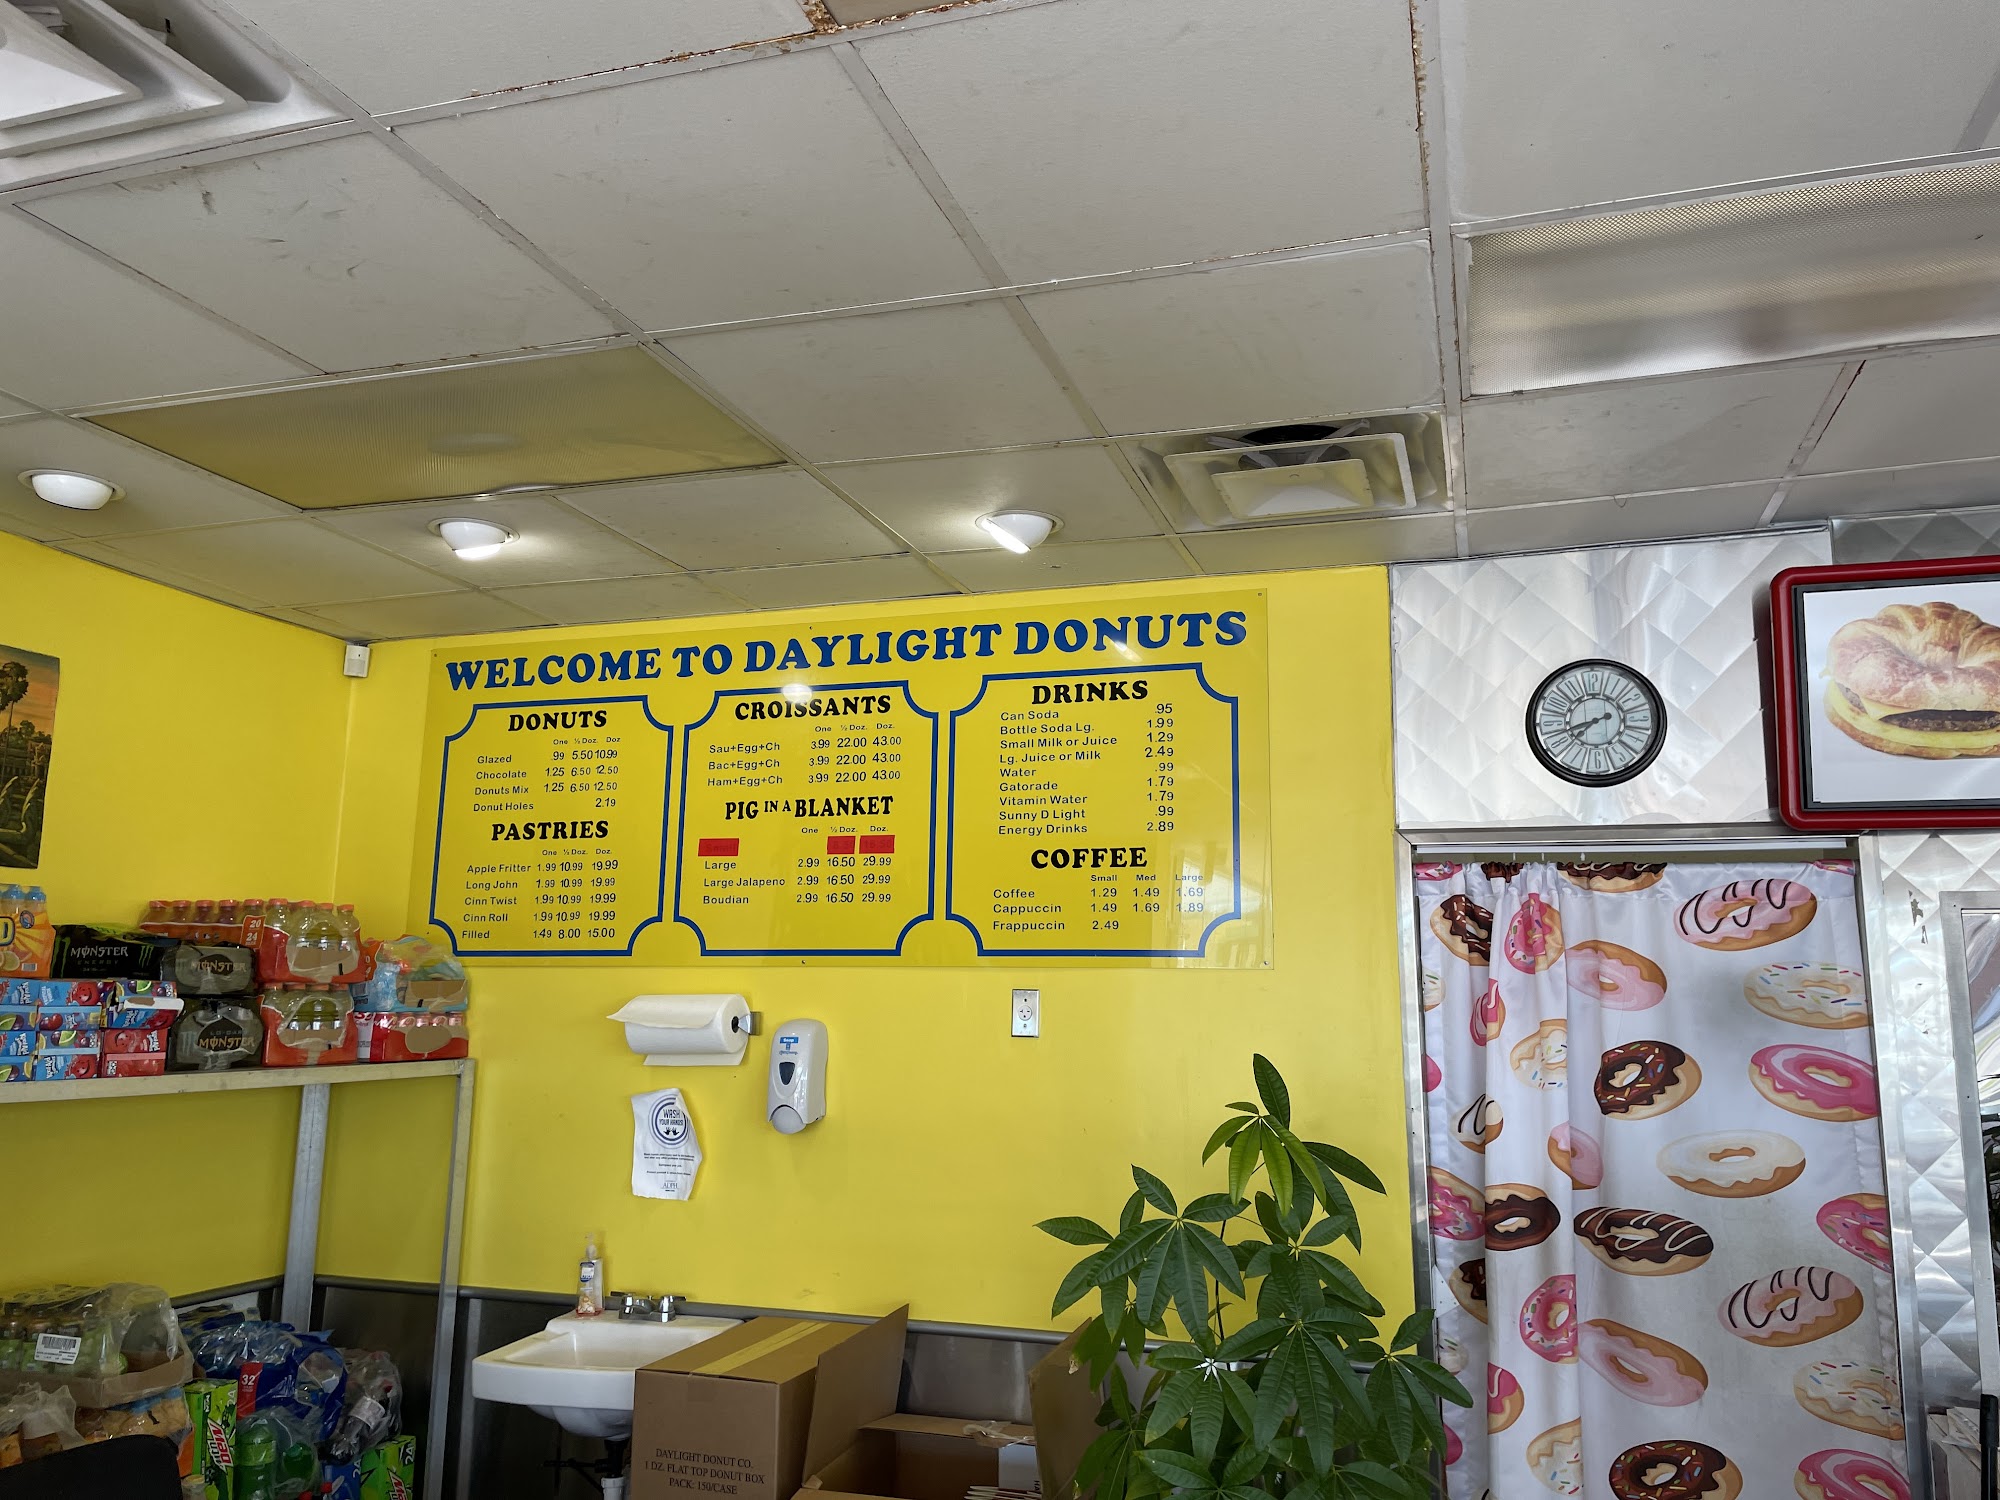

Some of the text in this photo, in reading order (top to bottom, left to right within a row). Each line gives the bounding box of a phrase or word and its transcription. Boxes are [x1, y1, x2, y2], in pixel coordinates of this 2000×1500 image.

[446, 611, 1246, 690] WELCOME TO DAYLIGHT DONUTS
[1588, 673, 1598, 691] 12
[1032, 680, 1148, 704] DRINKS
[735, 695, 890, 720] CROISSANTS
[1001, 704, 1172, 720] Can Soda .95
[508, 710, 606, 731] DONUTS
[1001, 718, 1173, 734] Bottle Soda Lg. 1.99
[710, 736, 901, 753] Sau+Egg+Ch 3.99 22.00 43.00
[1001, 739, 1033, 748] Small
[1038, 738, 1062, 747] Milk
[1082, 736, 1116, 745] Juice
[1147, 732, 1173, 742] 1.29
[478, 750, 617, 764] Glazed .99 5.50 10.99
[709, 753, 900, 770] Bac+Egg+Ch 3.99 22.00 43.00
[1000, 755, 1017, 765] Lg.
[1022, 753, 1055, 762] Juice
[1076, 751, 1100, 760] Milk
[1145, 746, 1173, 757] 2.49
[476, 765, 618, 779] Chocolate 1.25 6.50 12.50
[1000, 763, 1173, 777] Water .99
[708, 770, 900, 787] Ham+Egg+Ch 3.99 22.00 43.00
[1000, 776, 1173, 791] Gatorade 1.79
[475, 787, 509, 795] Donuts
[544, 782, 564, 792] 1.25
[570, 783, 589, 792] 6.50
[594, 782, 617, 791] 12.50
[474, 798, 615, 811] Donut Holes 2.19
[1000, 791, 1173, 805] Vitamin Water 1.79
[726, 796, 893, 820] PIG IN A BLANKET
[1000, 806, 1173, 821] Sunny D Light .99
[492, 821, 608, 840] PASTRIES
[999, 821, 1173, 836] Energy Drinks 2.89
[705, 856, 891, 871] Large 2.99 16.50 29.99
[1031, 847, 1147, 869] COFFEE
[467, 860, 618, 875] Apple Fritter 1.99 10.99 19.99
[466, 881, 490, 891] Long
[536, 879, 555, 888] 1.99
[560, 879, 582, 888] 10.99
[591, 877, 615, 886] 19.99
[704, 873, 890, 888] Large Jalapeno 2.99 16.50 29.99
[465, 897, 487, 905] Cinn
[535, 894, 554, 904] 1.99
[557, 894, 581, 904] 10.99
[590, 893, 616, 903] 19.99
[704, 892, 891, 904] Boudian 2.99 16.50 29.99
[994, 887, 1204, 898] Coffee 1.29 1.49 1.69
[464, 914, 486, 922] Cinn
[534, 912, 552, 921] 1.99
[556, 911, 580, 922] 10.99
[589, 911, 615, 921] 19.99
[994, 903, 1204, 915] Cappuccin 1.49 1.69 1.89
[462, 928, 615, 939] Filled 1.49 8.00 15.00
[994, 921, 1118, 932] Frappuccin 2.49
[71, 946, 128, 958] MONSTER
[663, 1109, 680, 1118] WASH
[242, 1375, 255, 1386] 32
[656, 1449, 754, 1468] DAYLIGHT DONUT CO.
[667, 1464, 689, 1474] FLAT
[691, 1467, 708, 1477] TOP
[710, 1469, 743, 1481] DONUT
[745, 1474, 765, 1484] BOX
[669, 1477, 738, 1494] PACK: 150/CASE
